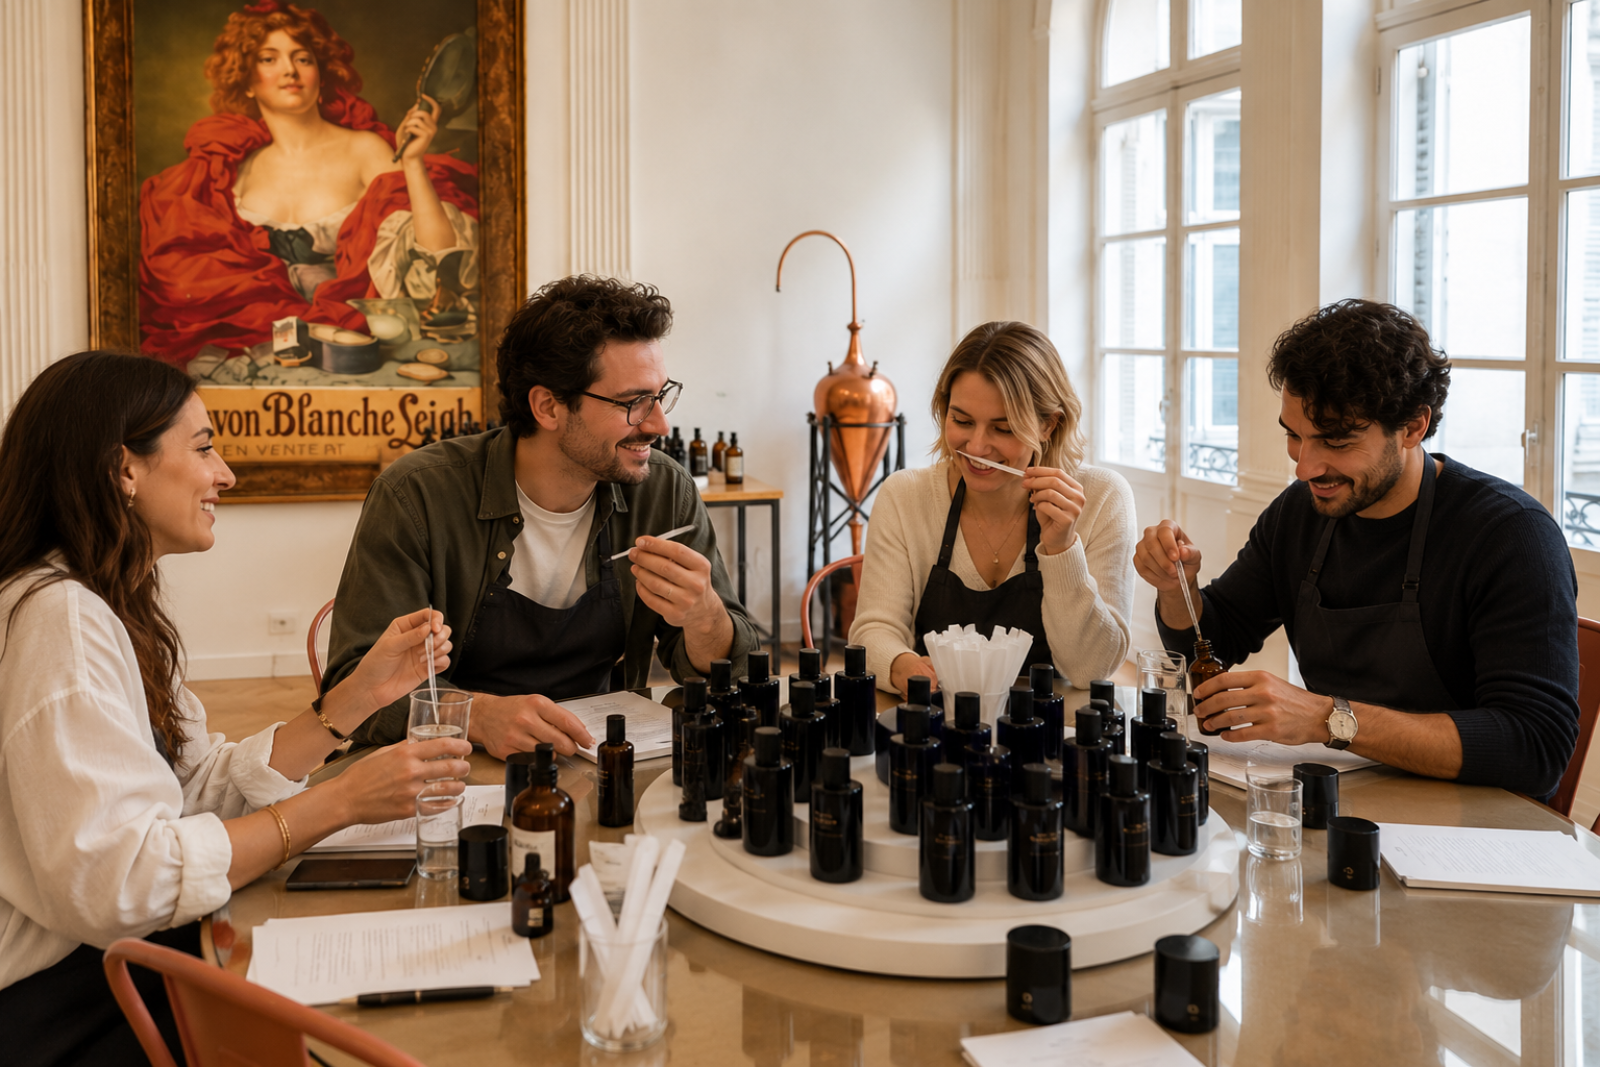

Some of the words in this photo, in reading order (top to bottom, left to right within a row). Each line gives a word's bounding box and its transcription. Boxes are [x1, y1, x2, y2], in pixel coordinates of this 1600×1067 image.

[207, 409, 261, 437] von
[262, 391, 395, 437] Blanche
[222, 444, 248, 457] EN
[256, 443, 319, 456] VENTE
